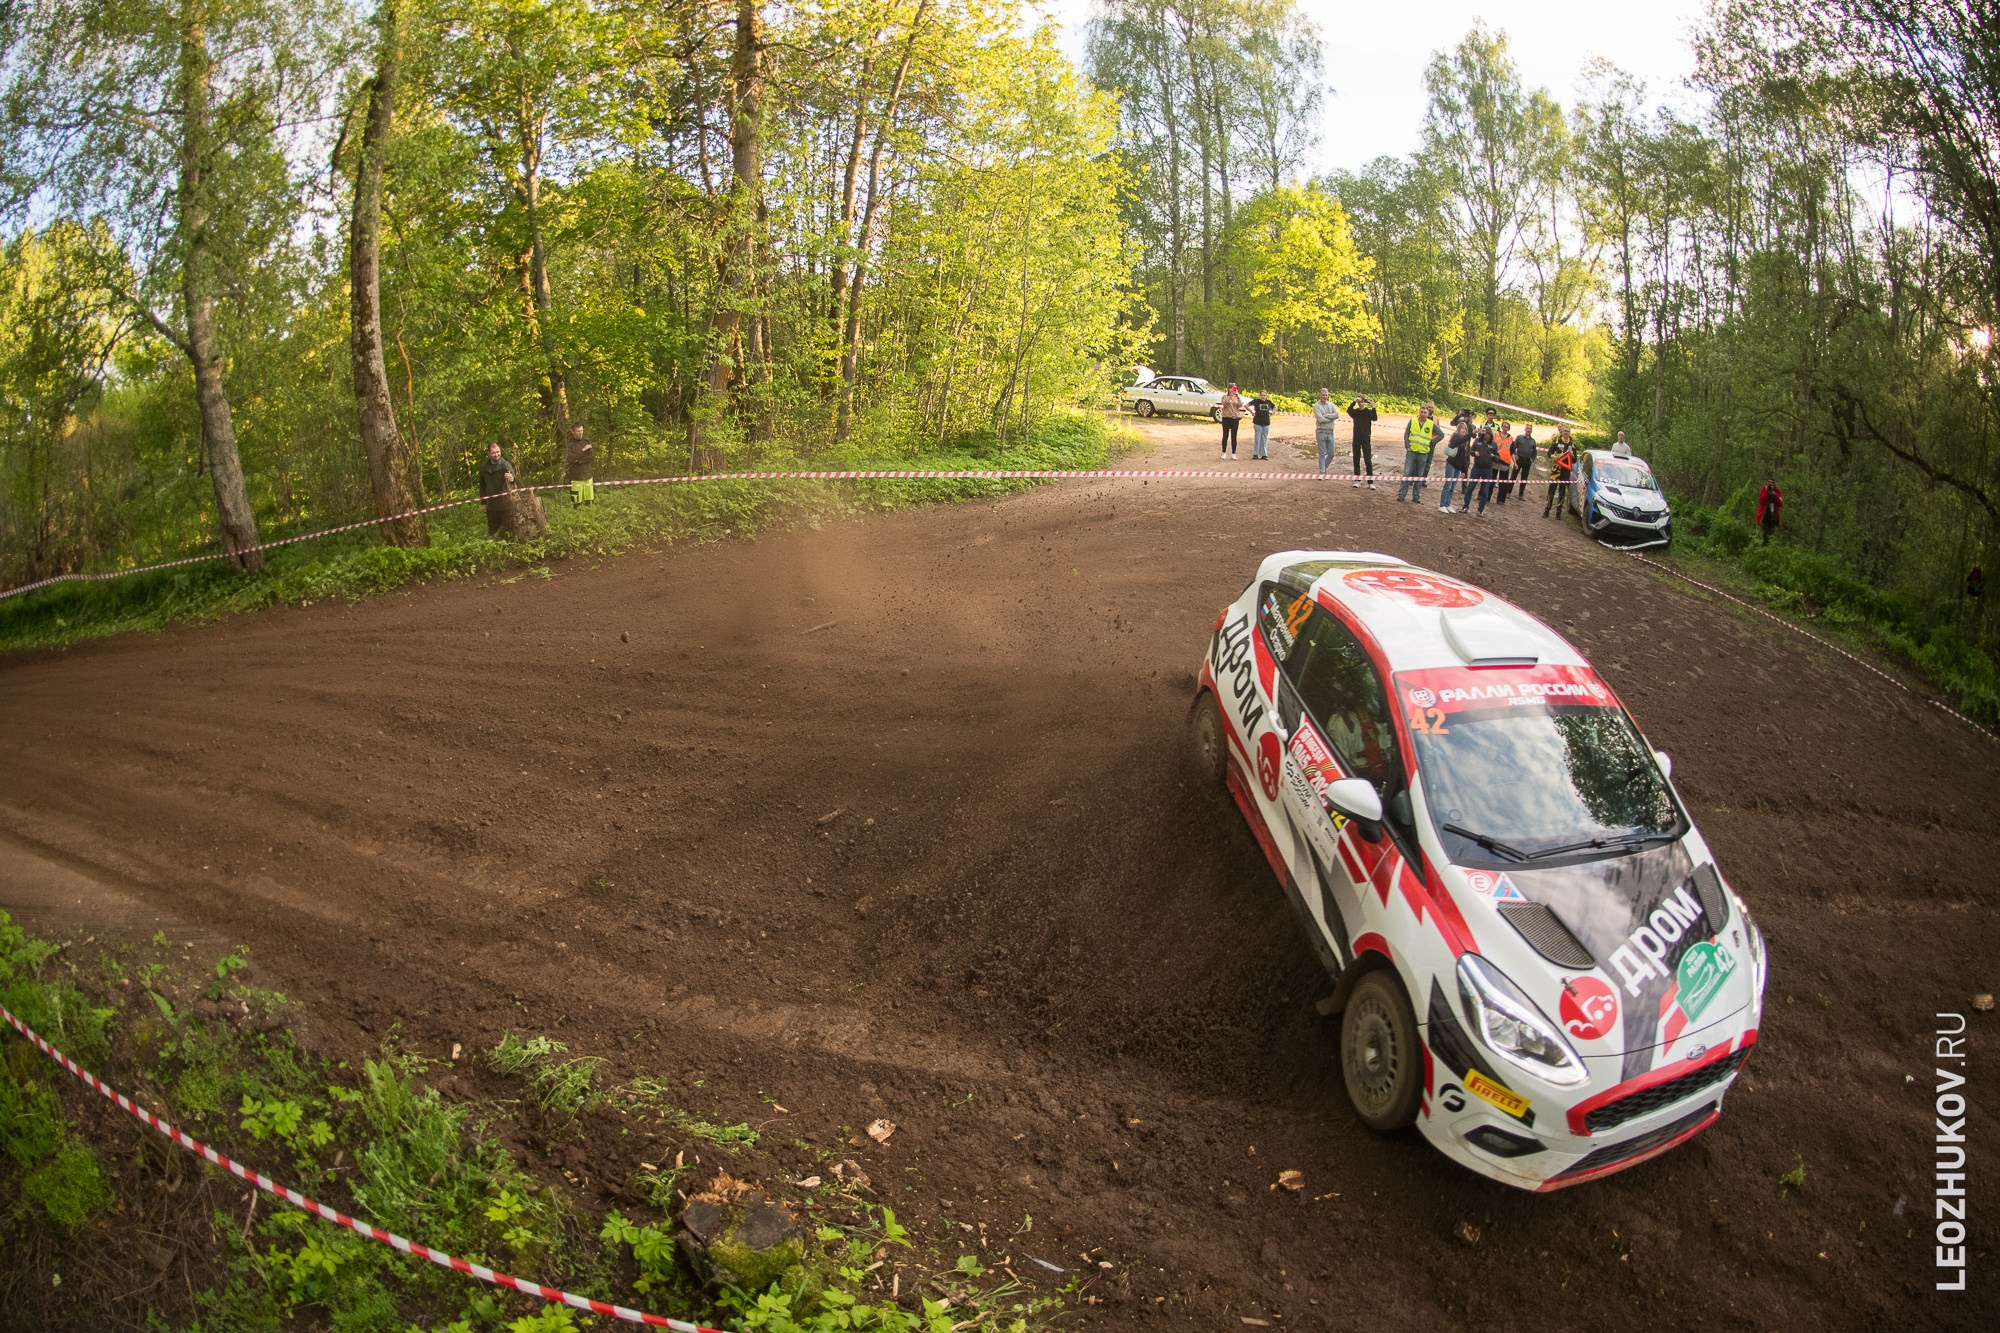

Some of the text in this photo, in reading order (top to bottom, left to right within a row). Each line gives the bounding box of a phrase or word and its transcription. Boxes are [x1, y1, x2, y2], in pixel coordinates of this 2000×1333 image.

[1287, 591, 1315, 638] 42
[1439, 683, 1590, 703] РАЛЛИ РОССИИ
[1410, 707, 1449, 735] 42
[1713, 945, 1736, 974] 42
[1468, 1075, 1523, 1111] PIRELLI
